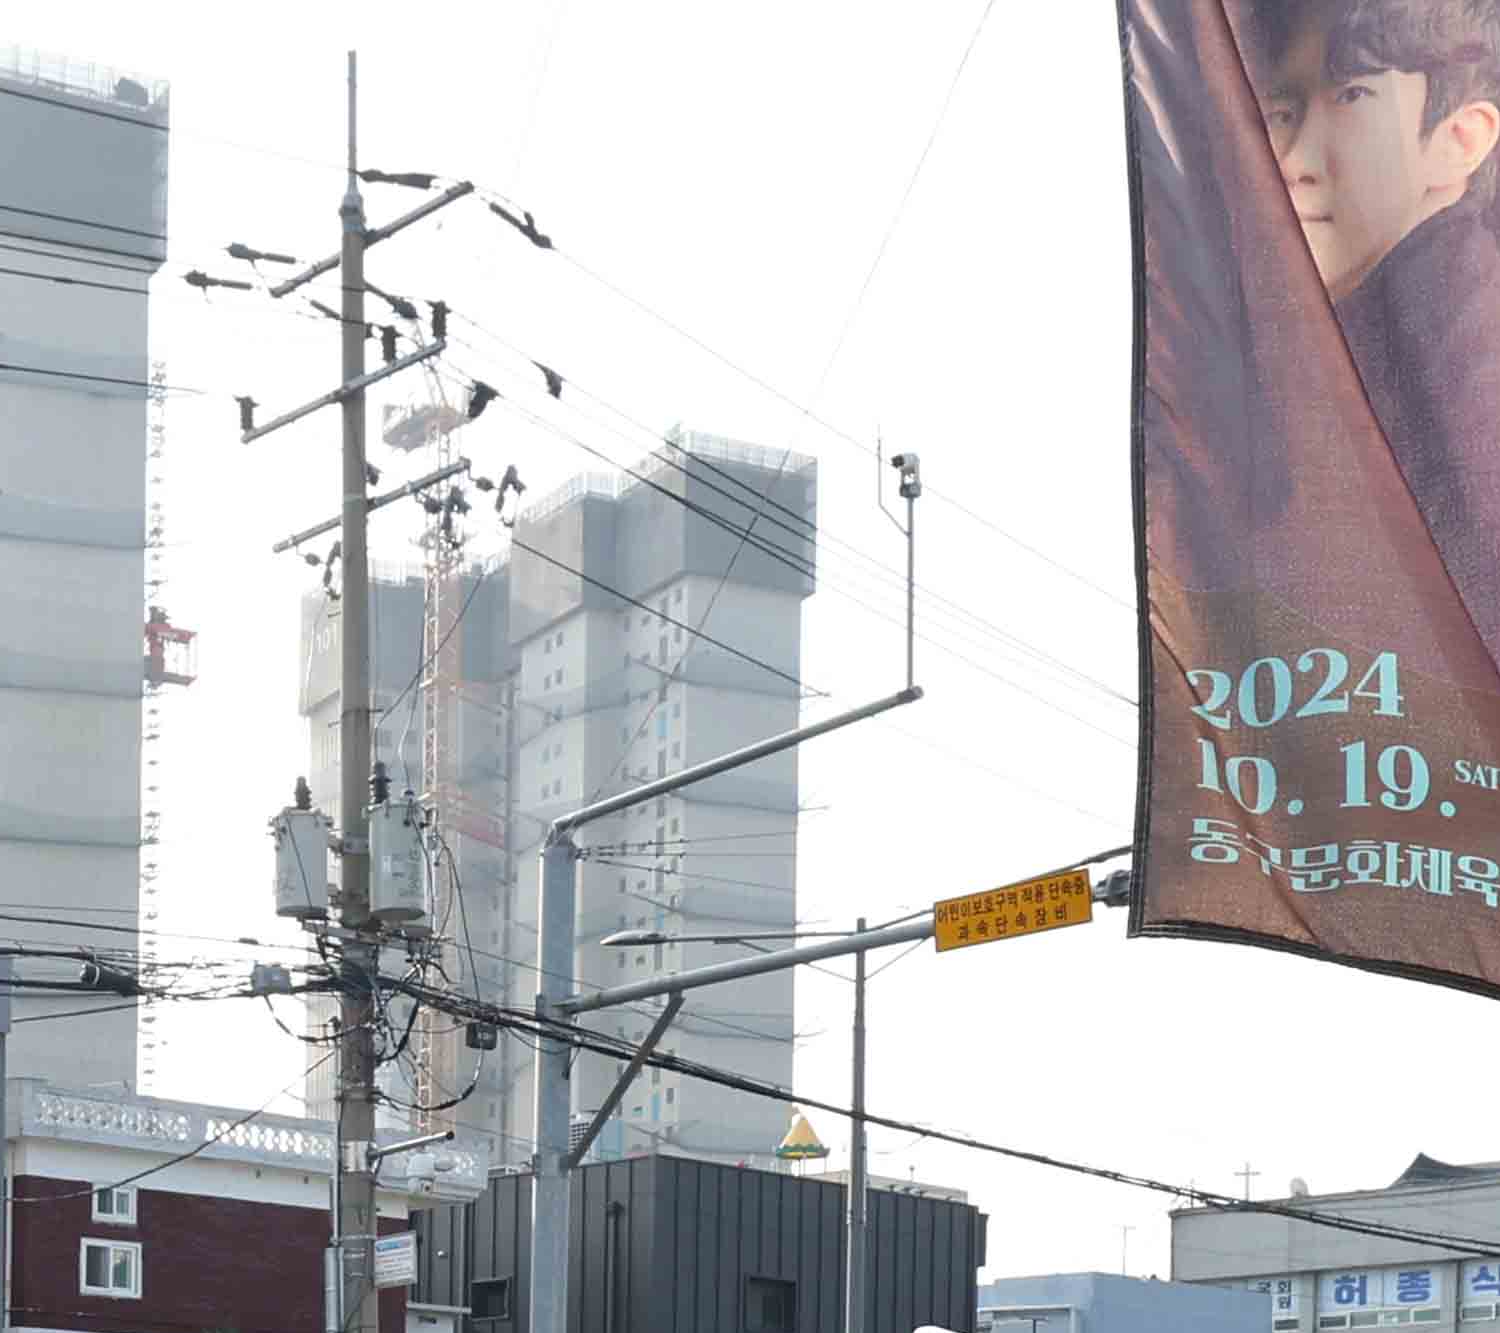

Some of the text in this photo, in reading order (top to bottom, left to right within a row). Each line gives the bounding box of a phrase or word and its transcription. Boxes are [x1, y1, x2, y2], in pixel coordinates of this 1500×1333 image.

[1187, 647, 1405, 731] 2024
[1195, 737, 1306, 817] 10.
[1339, 737, 1458, 818] 19.
